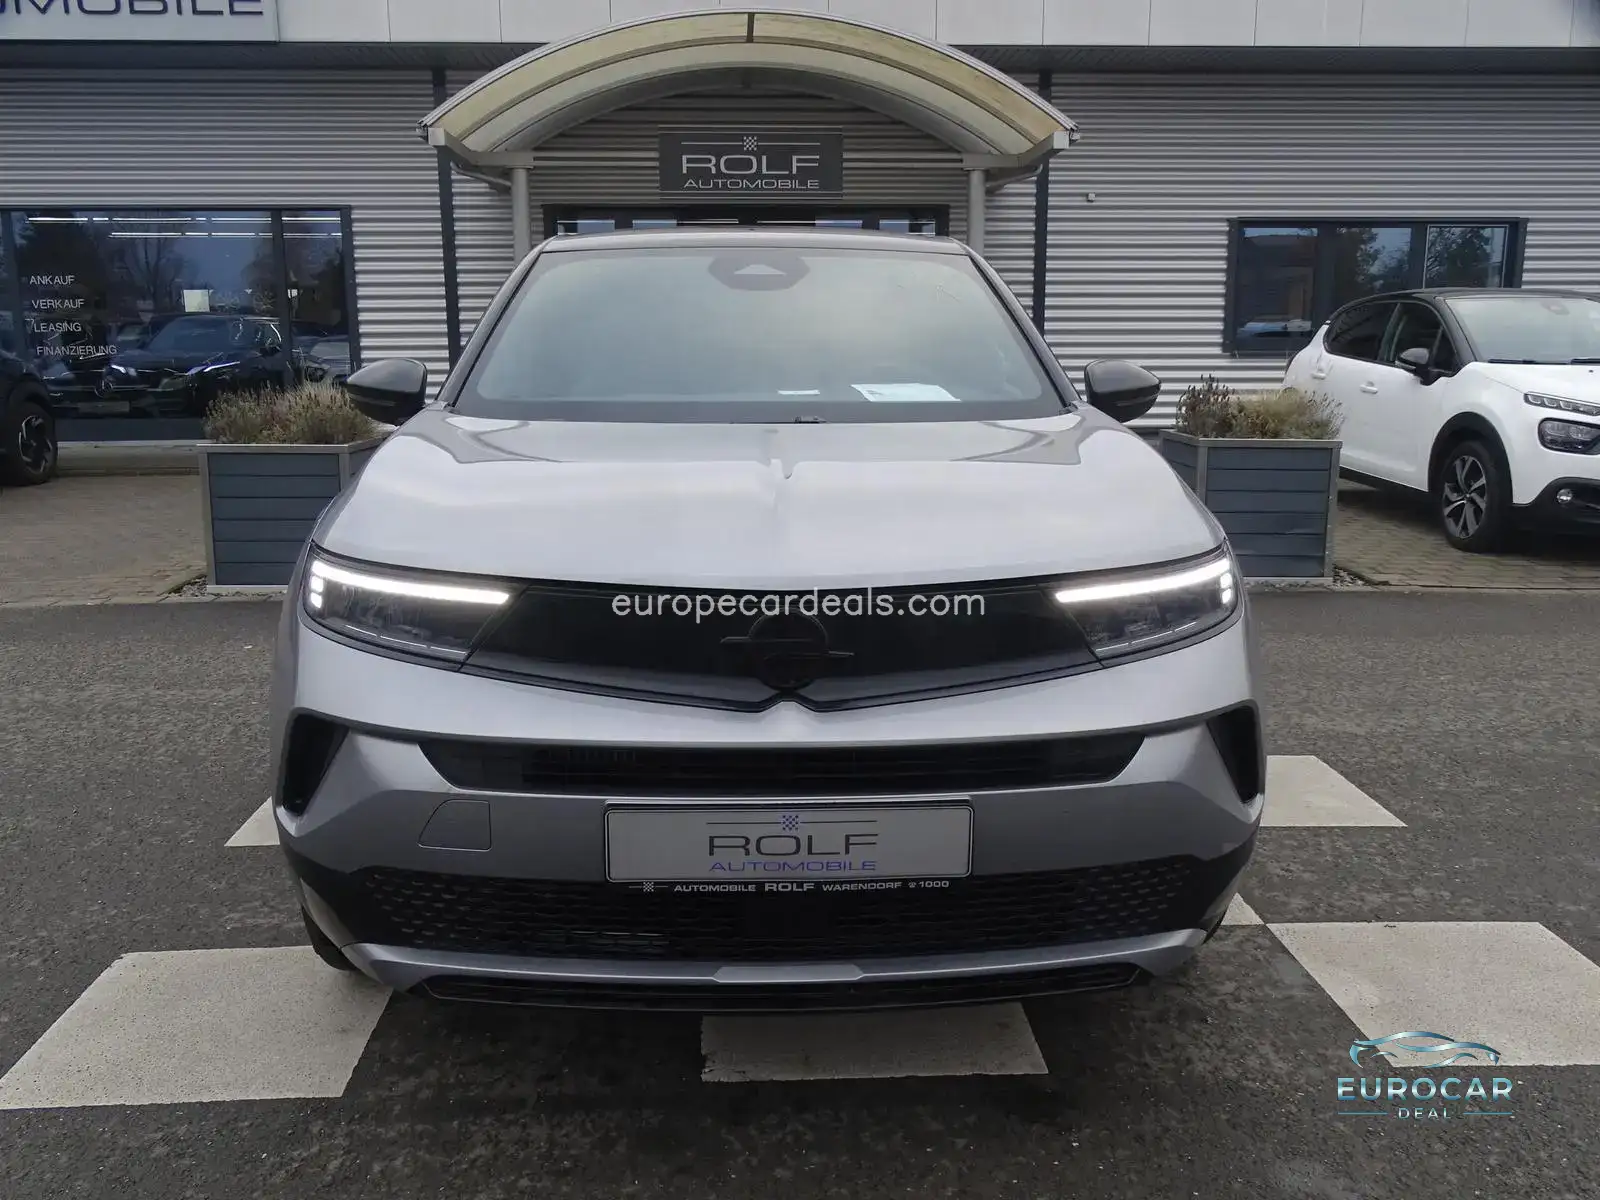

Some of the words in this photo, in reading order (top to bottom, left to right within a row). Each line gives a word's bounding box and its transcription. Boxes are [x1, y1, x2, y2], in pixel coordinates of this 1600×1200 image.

[0, 0, 264, 15] MOBILE
[682, 155, 820, 175] ROLF
[684, 179, 820, 189] AUTOMOBILE
[29, 275, 76, 285] ANKAUF
[31, 299, 85, 309] VERKAUF
[34, 322, 82, 333] LEASING
[36, 345, 118, 356] FINANZIERUNG
[709, 833, 879, 857] ROLF
[709, 861, 877, 872] AUTOMOBILE
[674, 884, 757, 892] AUTOMOBILE
[764, 882, 815, 892] ROLF
[822, 881, 903, 892] WARENDORF
